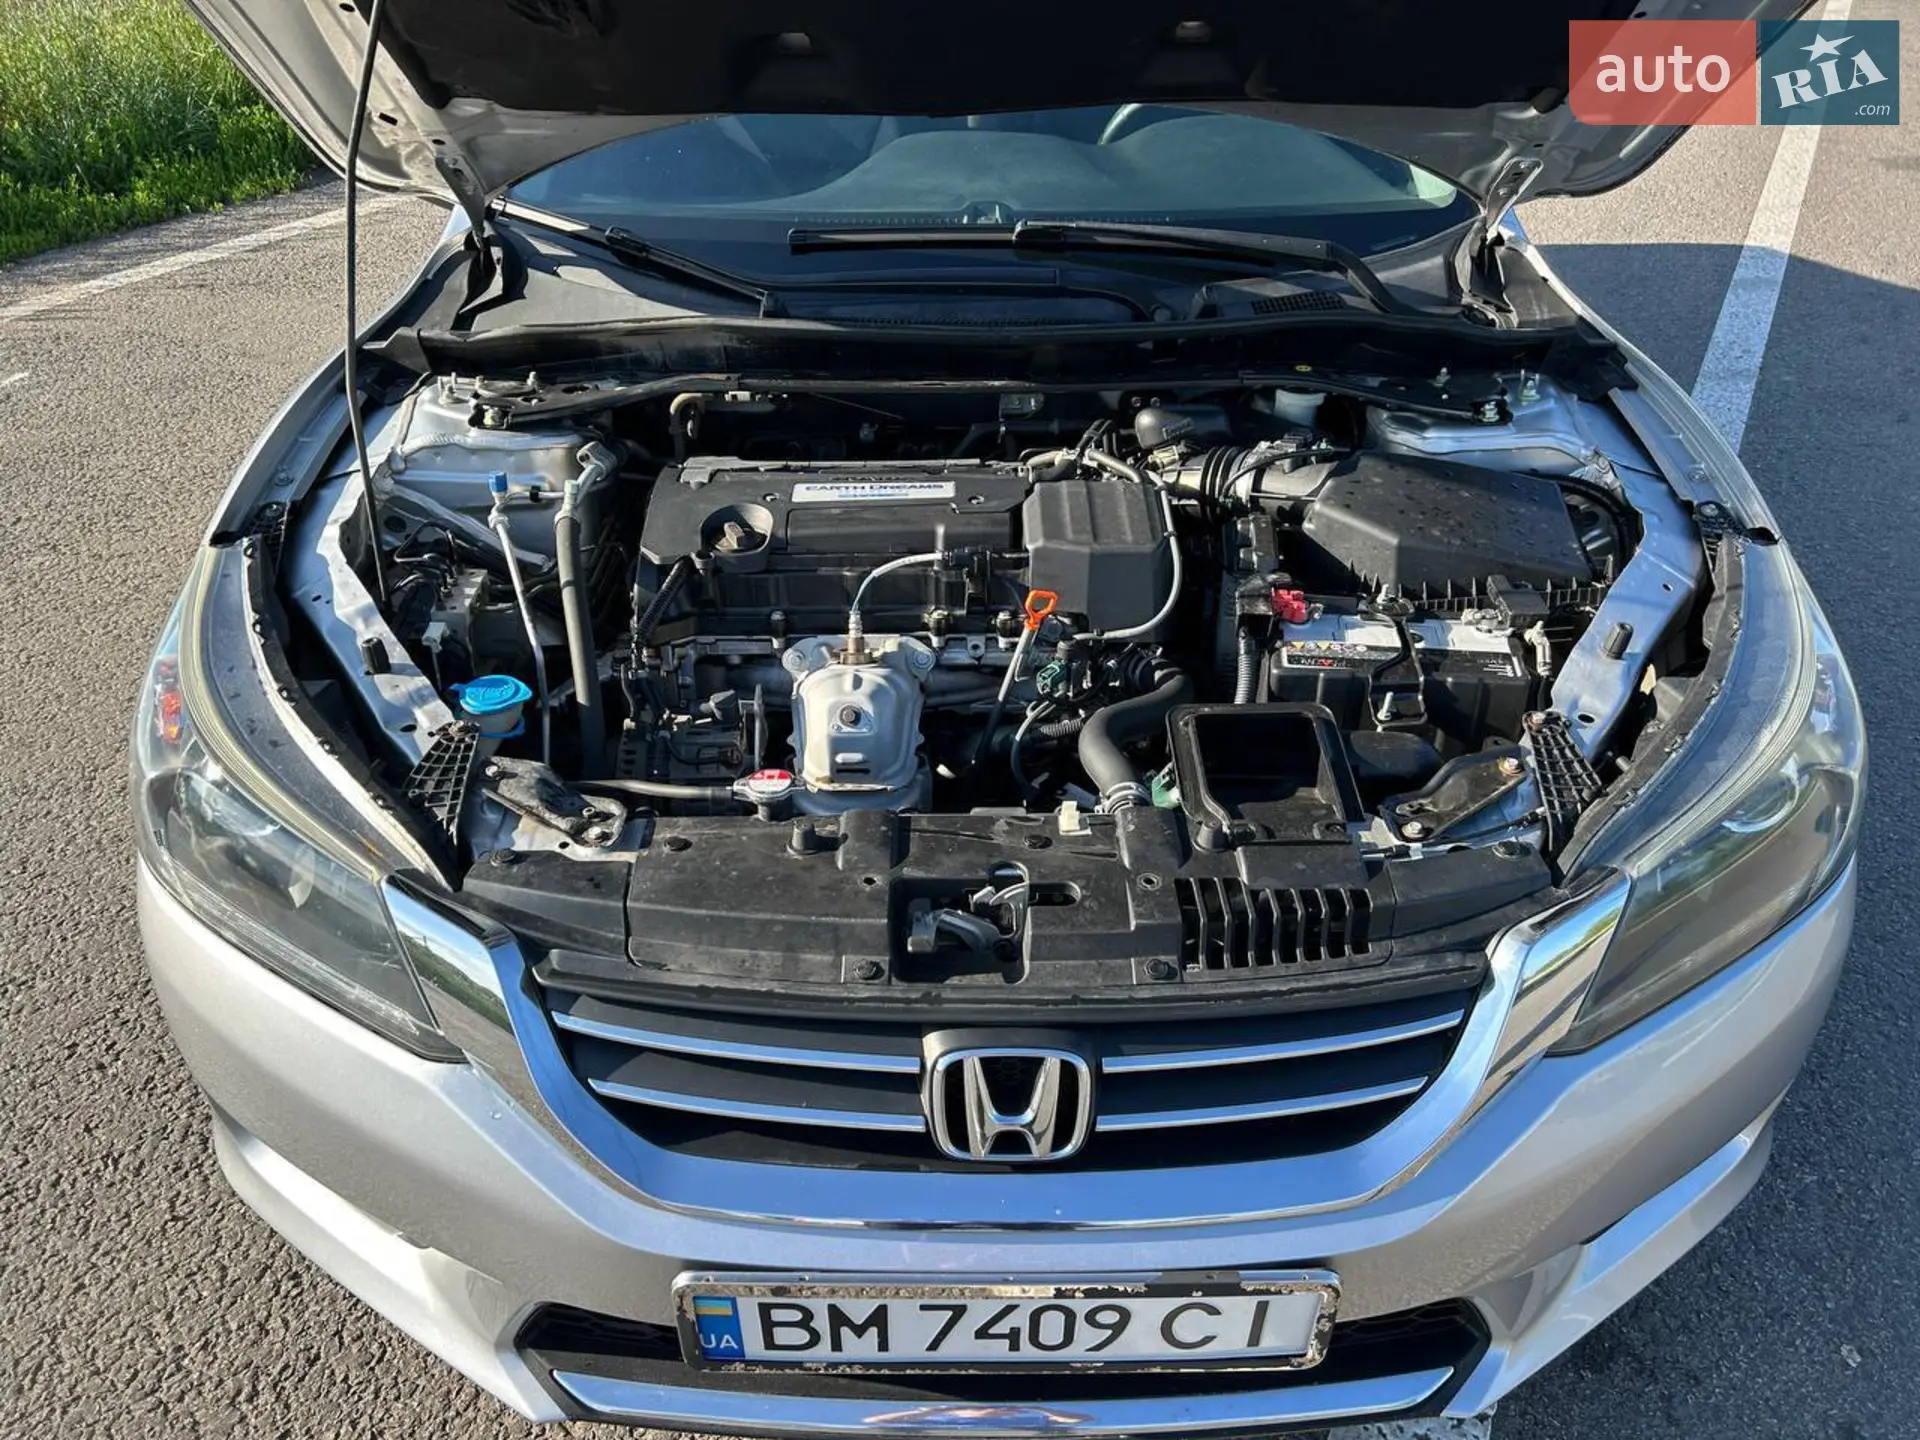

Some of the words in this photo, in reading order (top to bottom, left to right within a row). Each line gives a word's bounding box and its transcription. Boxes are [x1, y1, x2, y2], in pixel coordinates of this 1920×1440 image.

[700, 1334, 739, 1350] UA
[757, 1302, 889, 1353] BM
[918, 1303, 1132, 1353] 7409
